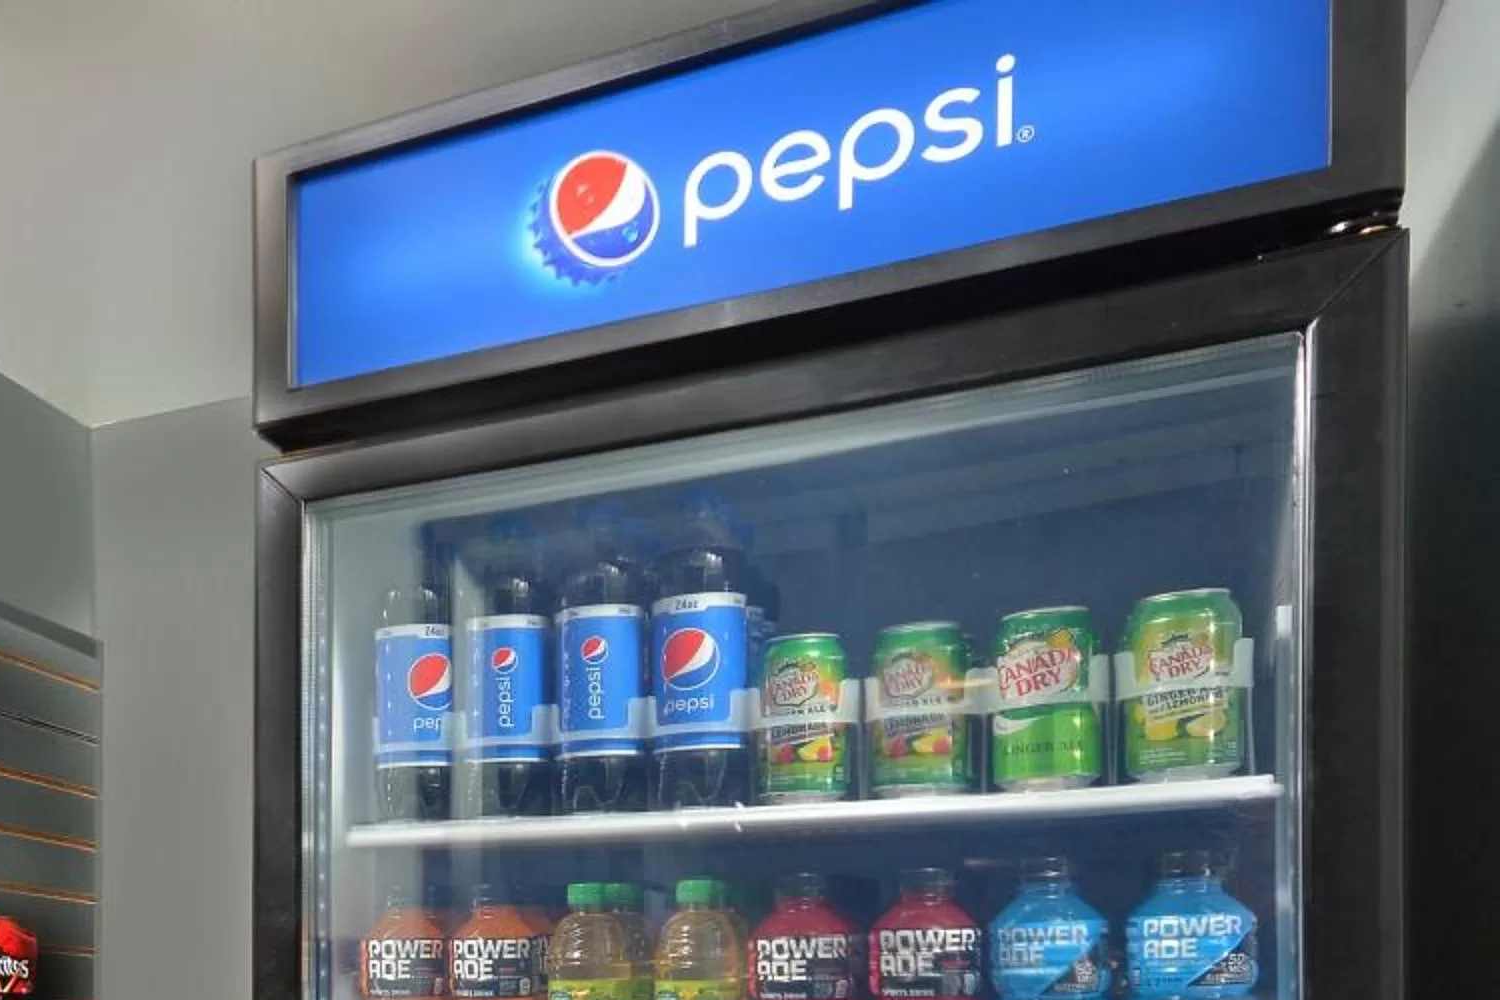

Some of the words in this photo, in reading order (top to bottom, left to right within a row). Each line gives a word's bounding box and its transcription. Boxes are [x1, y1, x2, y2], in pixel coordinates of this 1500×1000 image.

[684, 53, 1016, 248] pepsi
[1169, 660, 1201, 678] DRY
[588, 665, 602, 720] pepsi
[1015, 666, 1061, 697] DRY
[498, 670, 513, 728] pepsi
[663, 695, 715, 715] pepsi
[998, 923, 1090, 946] POWER
[1143, 915, 1243, 938] POWER
[368, 939, 443, 959] POWER
[453, 938, 529, 958] POWER
[757, 936, 848, 959] POWER
[880, 928, 975, 953] POWER
[1143, 939, 1199, 960] ADE
[368, 960, 411, 979] ADE
[453, 960, 493, 980] ADE
[757, 960, 807, 981] ADE
[881, 952, 935, 976] ADE
